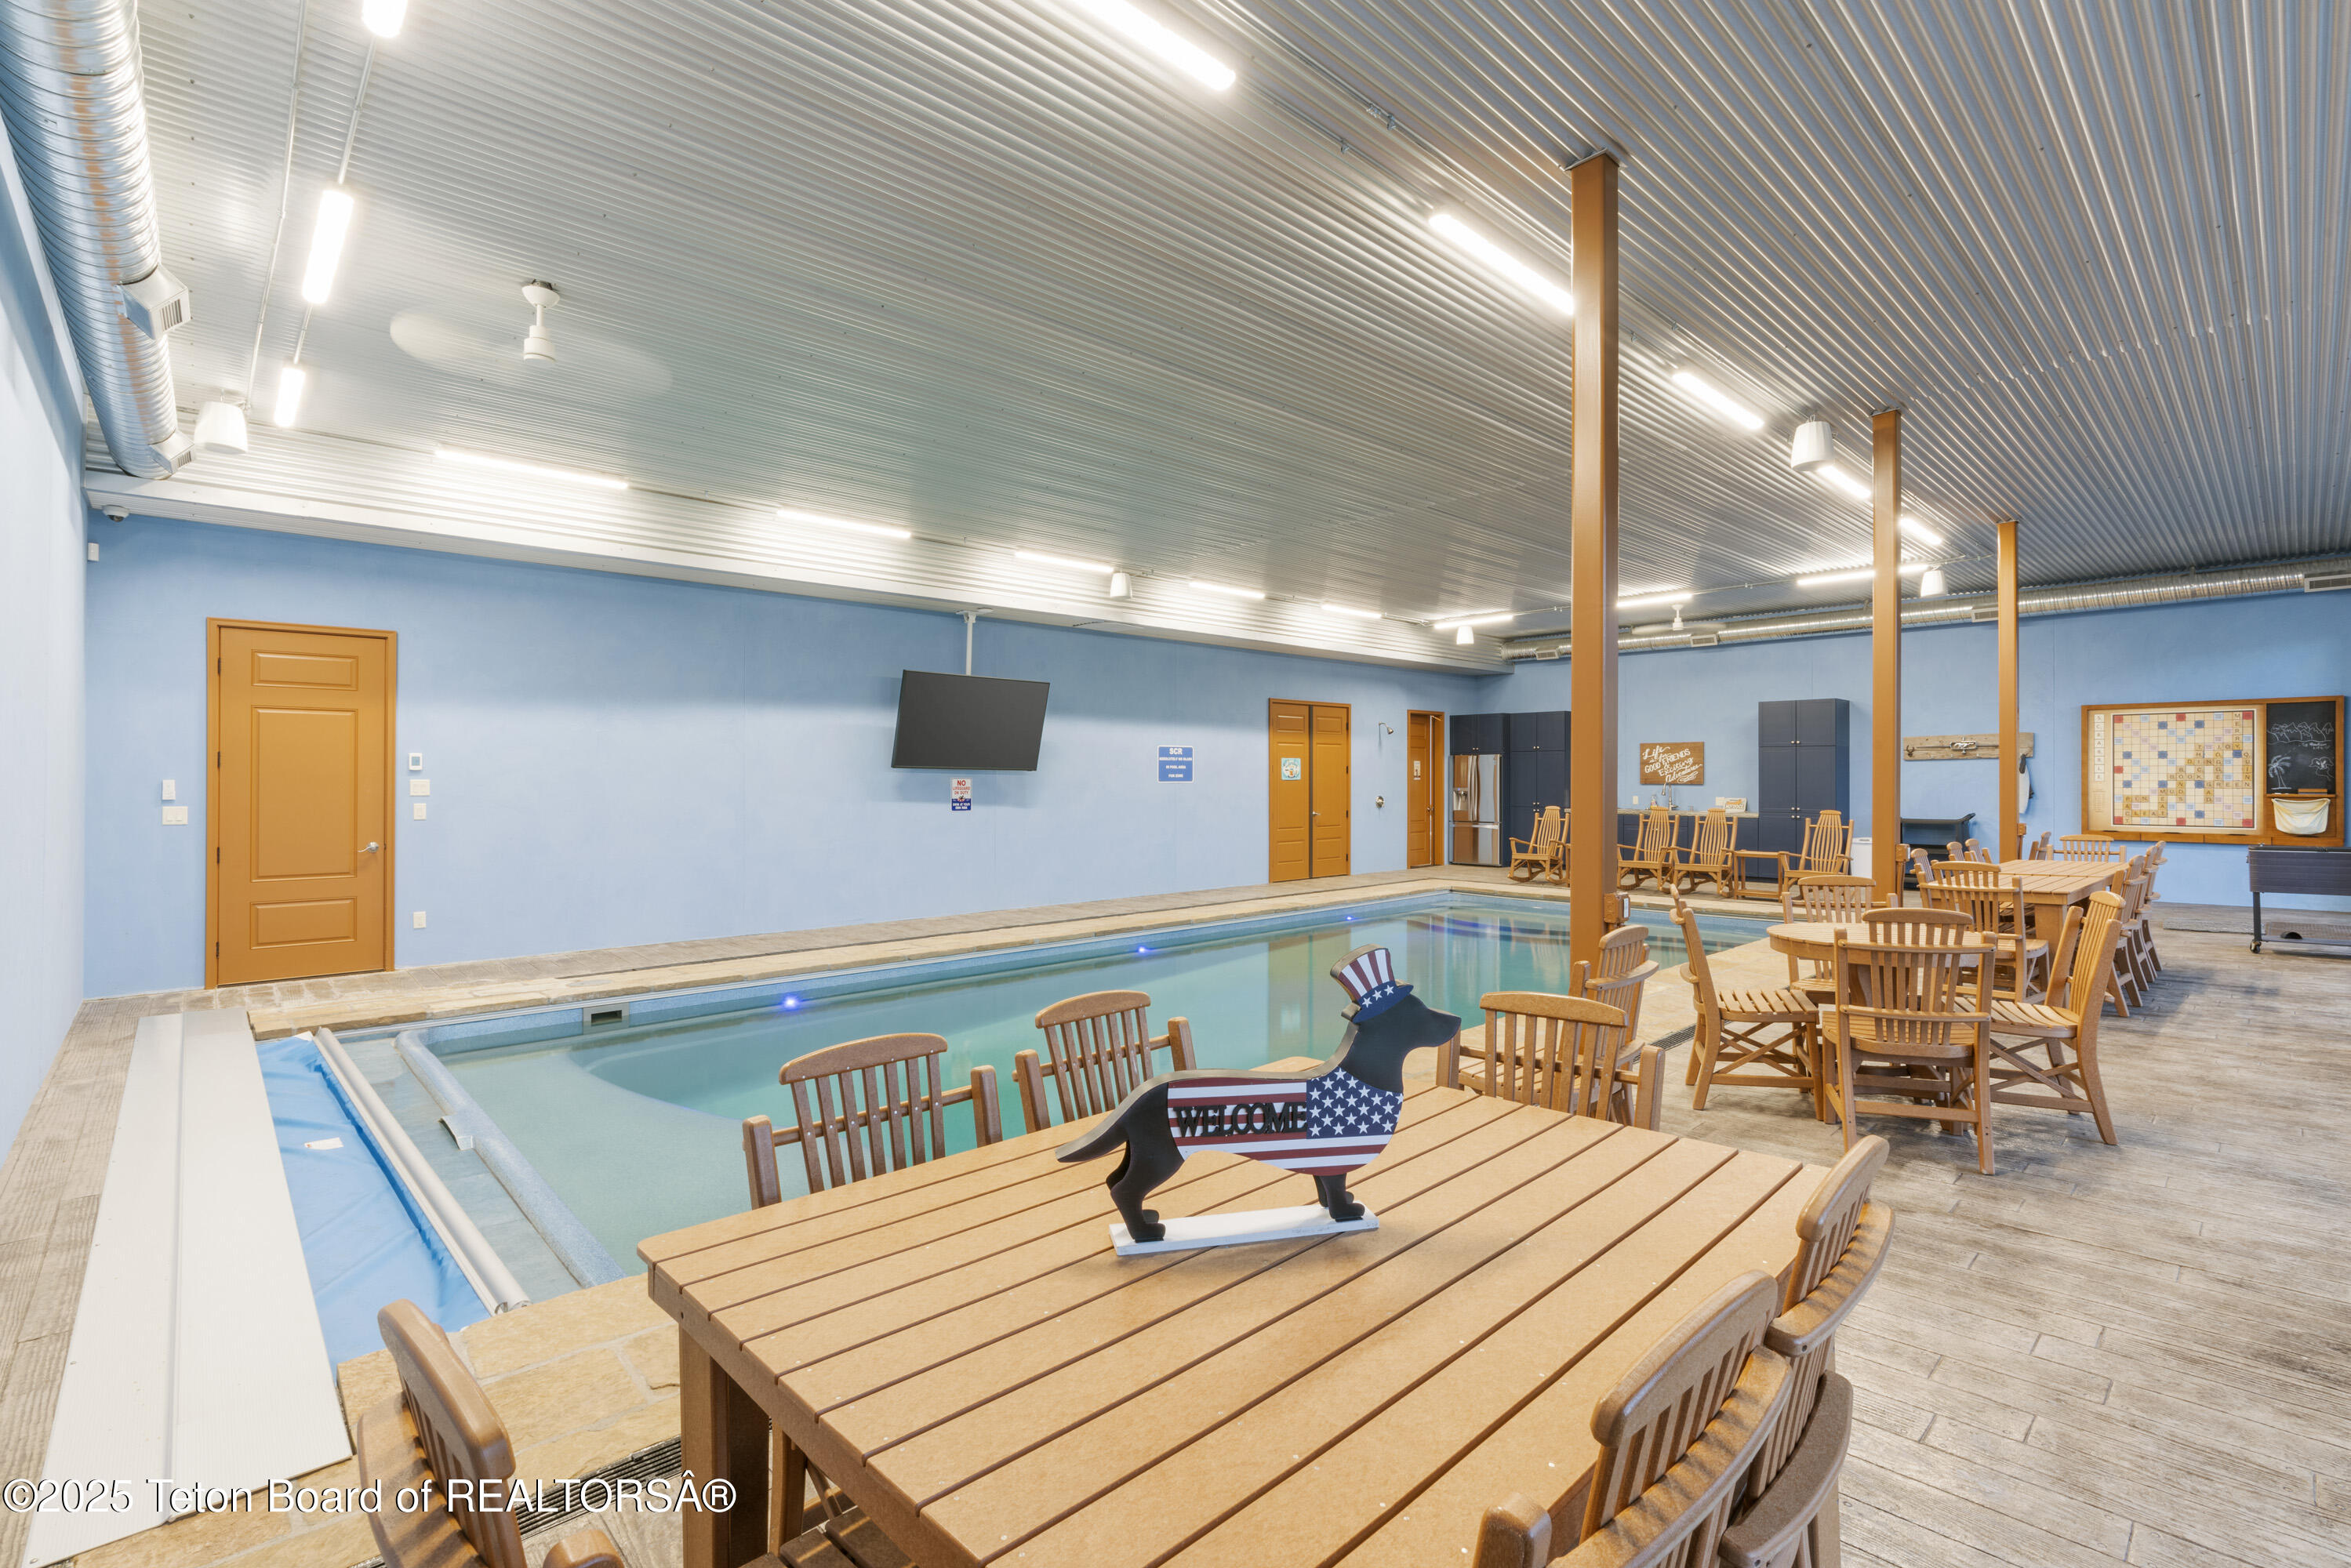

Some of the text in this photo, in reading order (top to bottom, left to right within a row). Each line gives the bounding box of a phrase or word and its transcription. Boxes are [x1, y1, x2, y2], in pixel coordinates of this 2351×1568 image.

[1642, 745, 1670, 760] Life
[1644, 748, 1691, 773] GOOD FRIENDS
[1173, 1102, 1306, 1138] WELCOME
